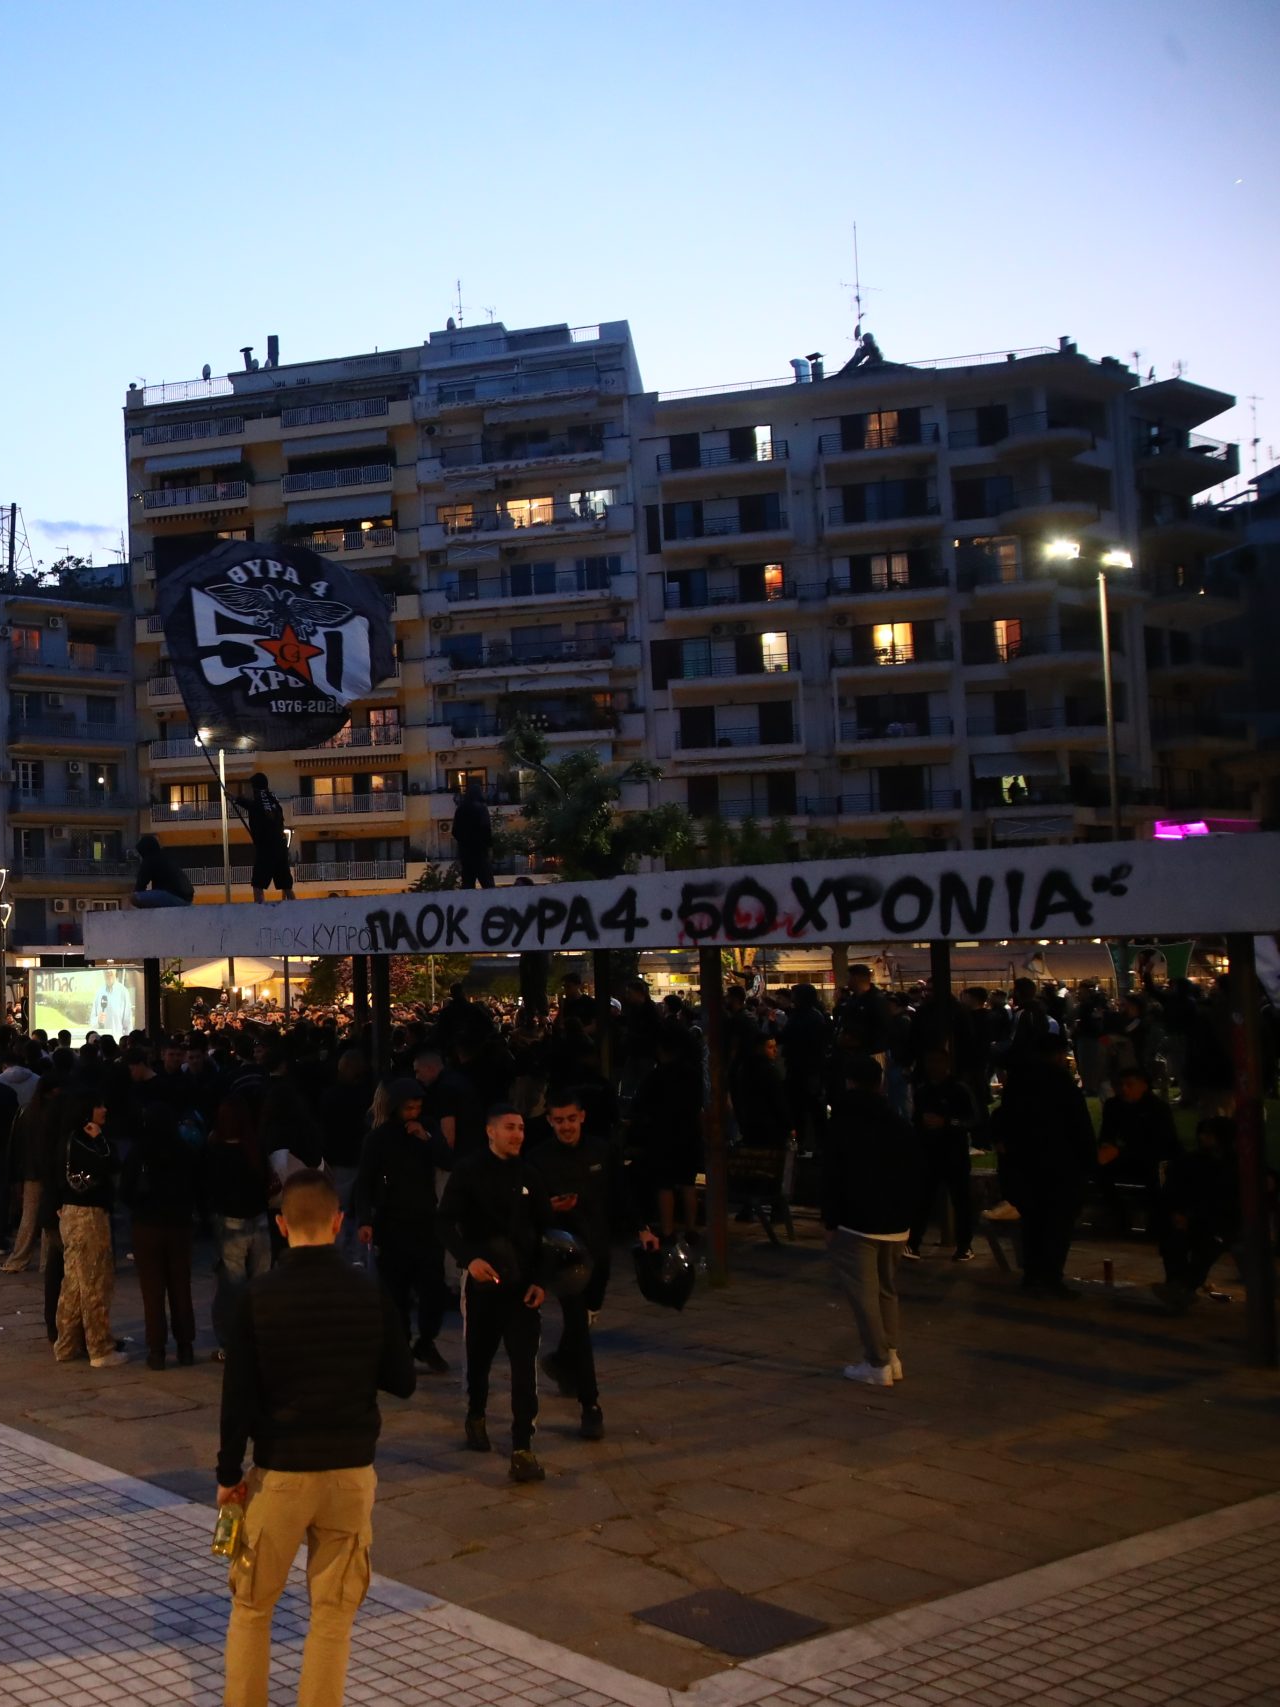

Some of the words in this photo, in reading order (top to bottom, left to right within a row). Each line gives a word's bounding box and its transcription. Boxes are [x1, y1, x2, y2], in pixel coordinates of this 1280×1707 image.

[226, 558, 302, 586] ΘΥΡΑ
[310, 580, 328, 598] 4
[365, 904, 470, 951] ΠΑΟΚ
[480, 892, 599, 947] ΘΥΡΑ
[791, 869, 1094, 935] ΧΡΟΝΙΑ
